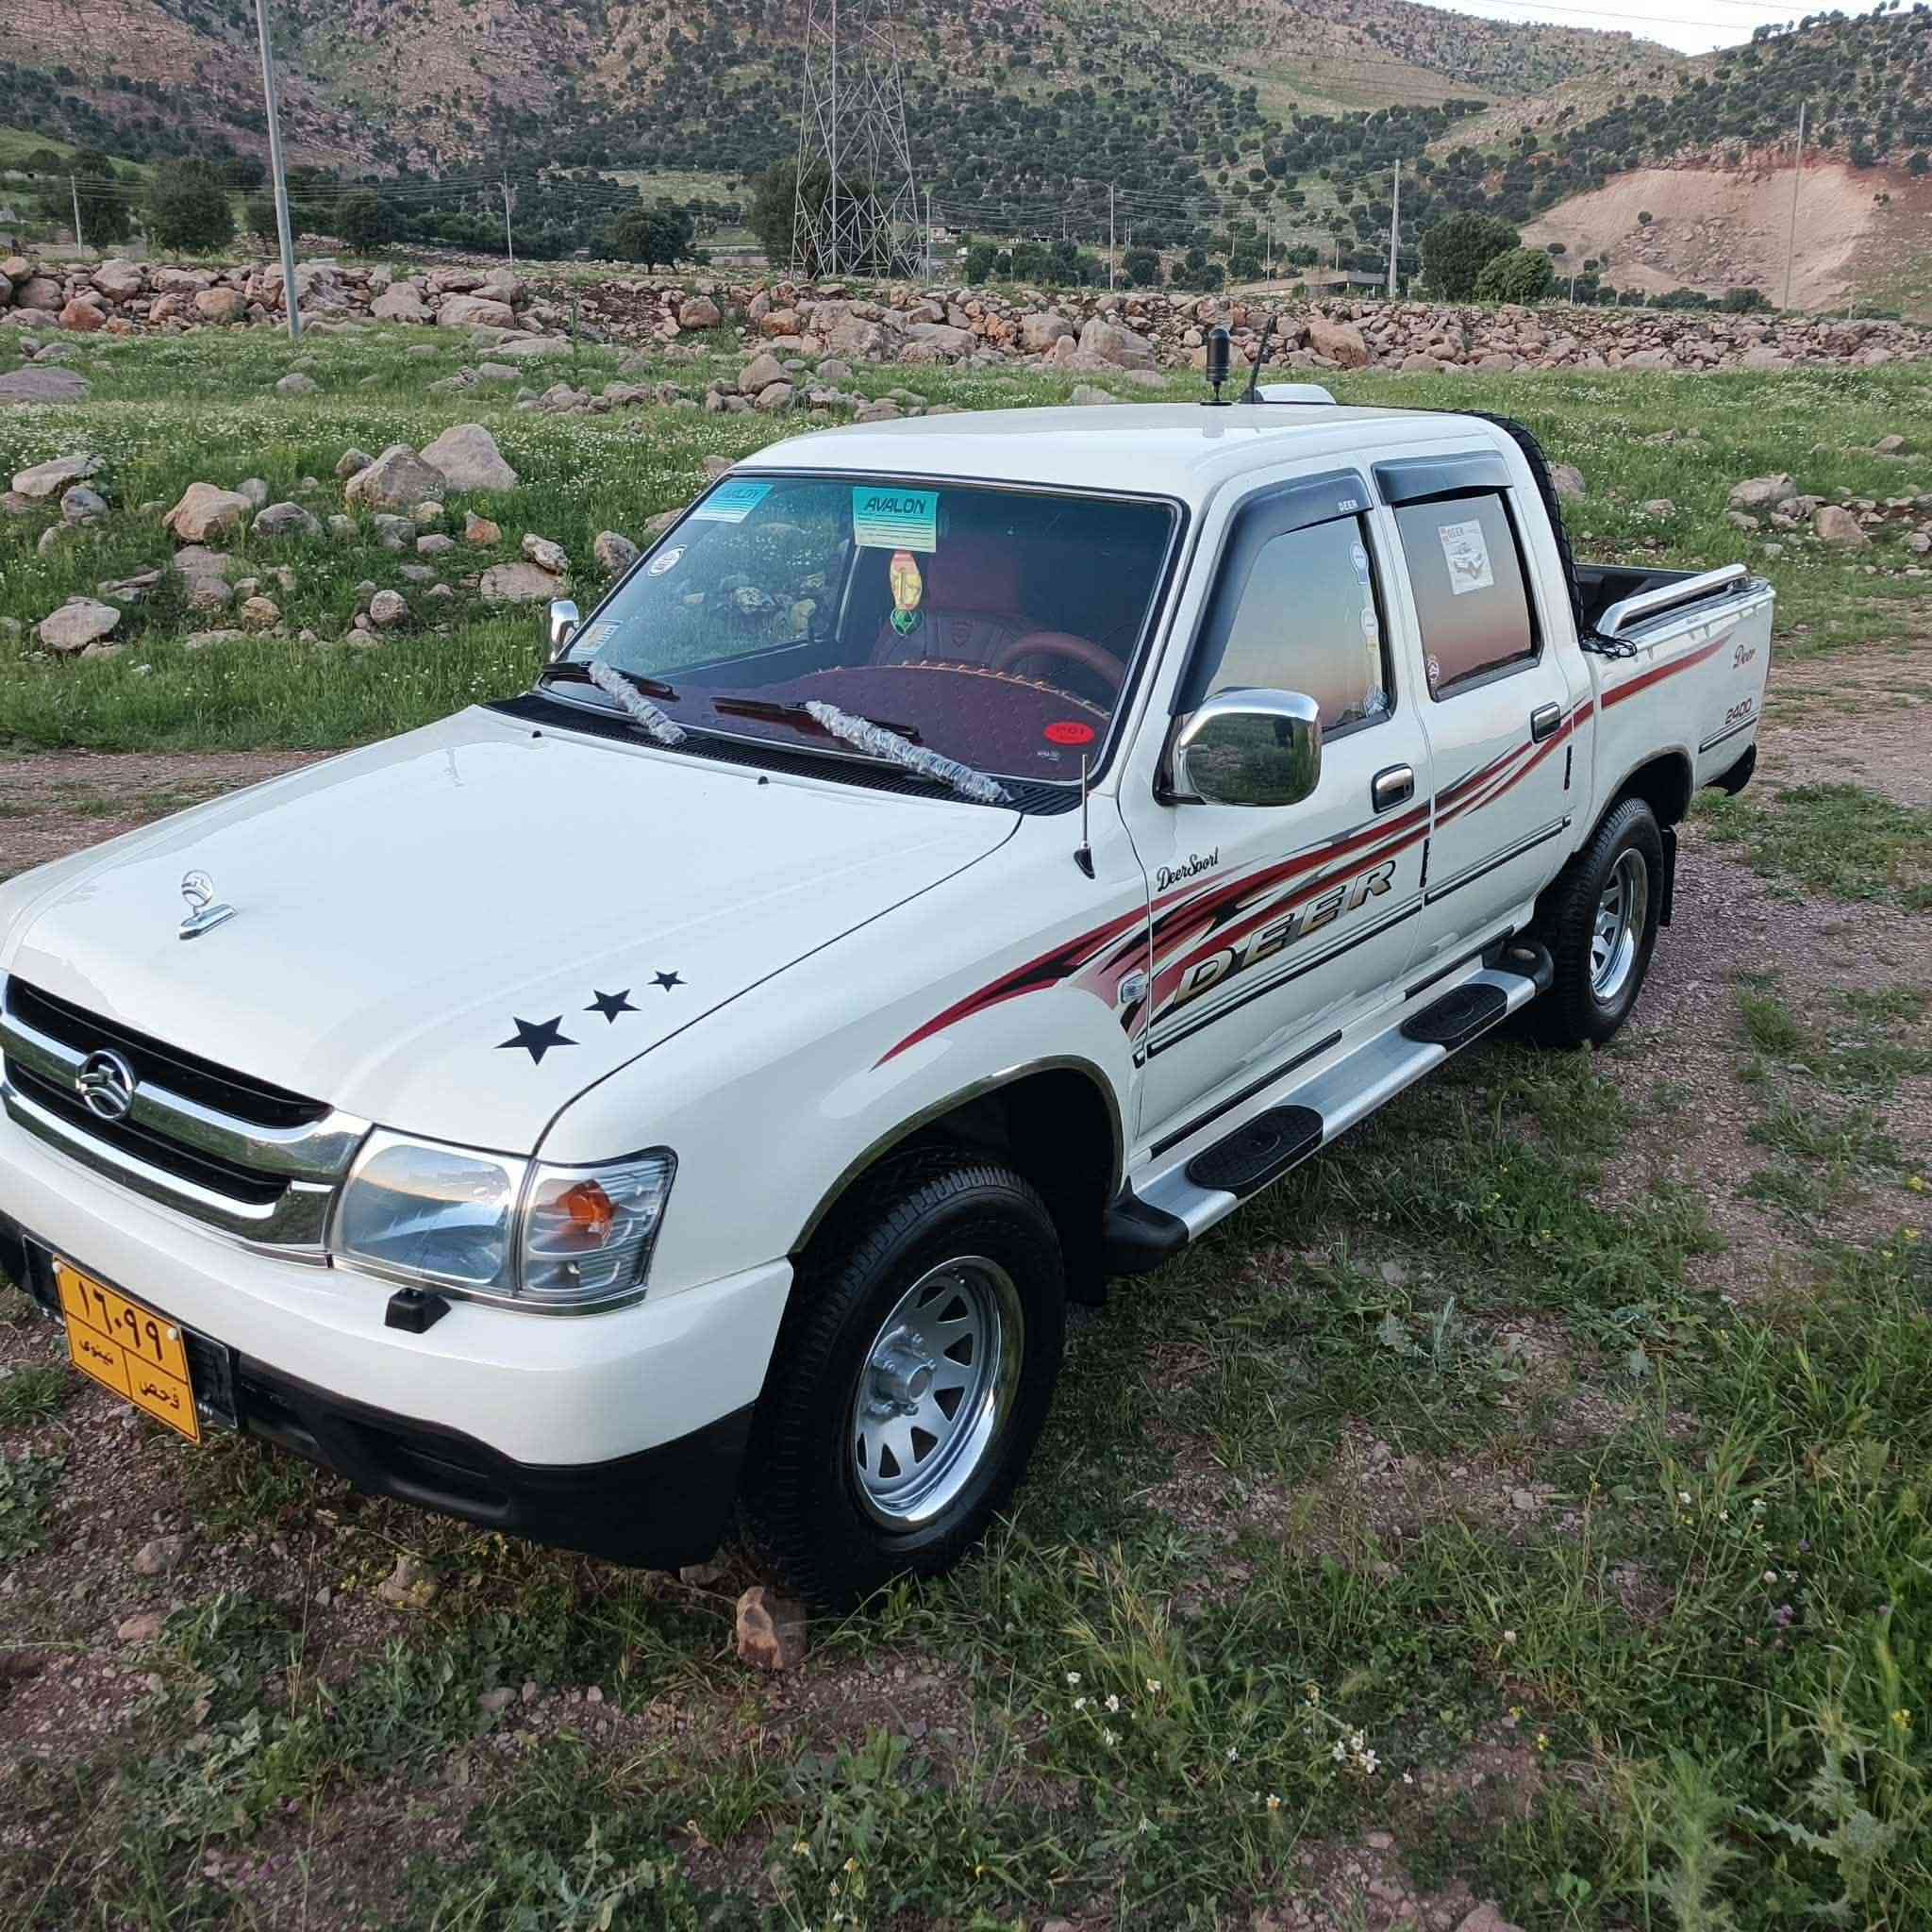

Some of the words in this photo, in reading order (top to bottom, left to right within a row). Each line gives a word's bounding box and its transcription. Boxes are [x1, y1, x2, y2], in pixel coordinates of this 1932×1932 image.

[864, 497, 926, 514] AVALON
[1725, 698, 1752, 724] 2400
[1174, 860, 1397, 1006] DEER
[79, 1281, 163, 1361] ١٦٠٩٩
